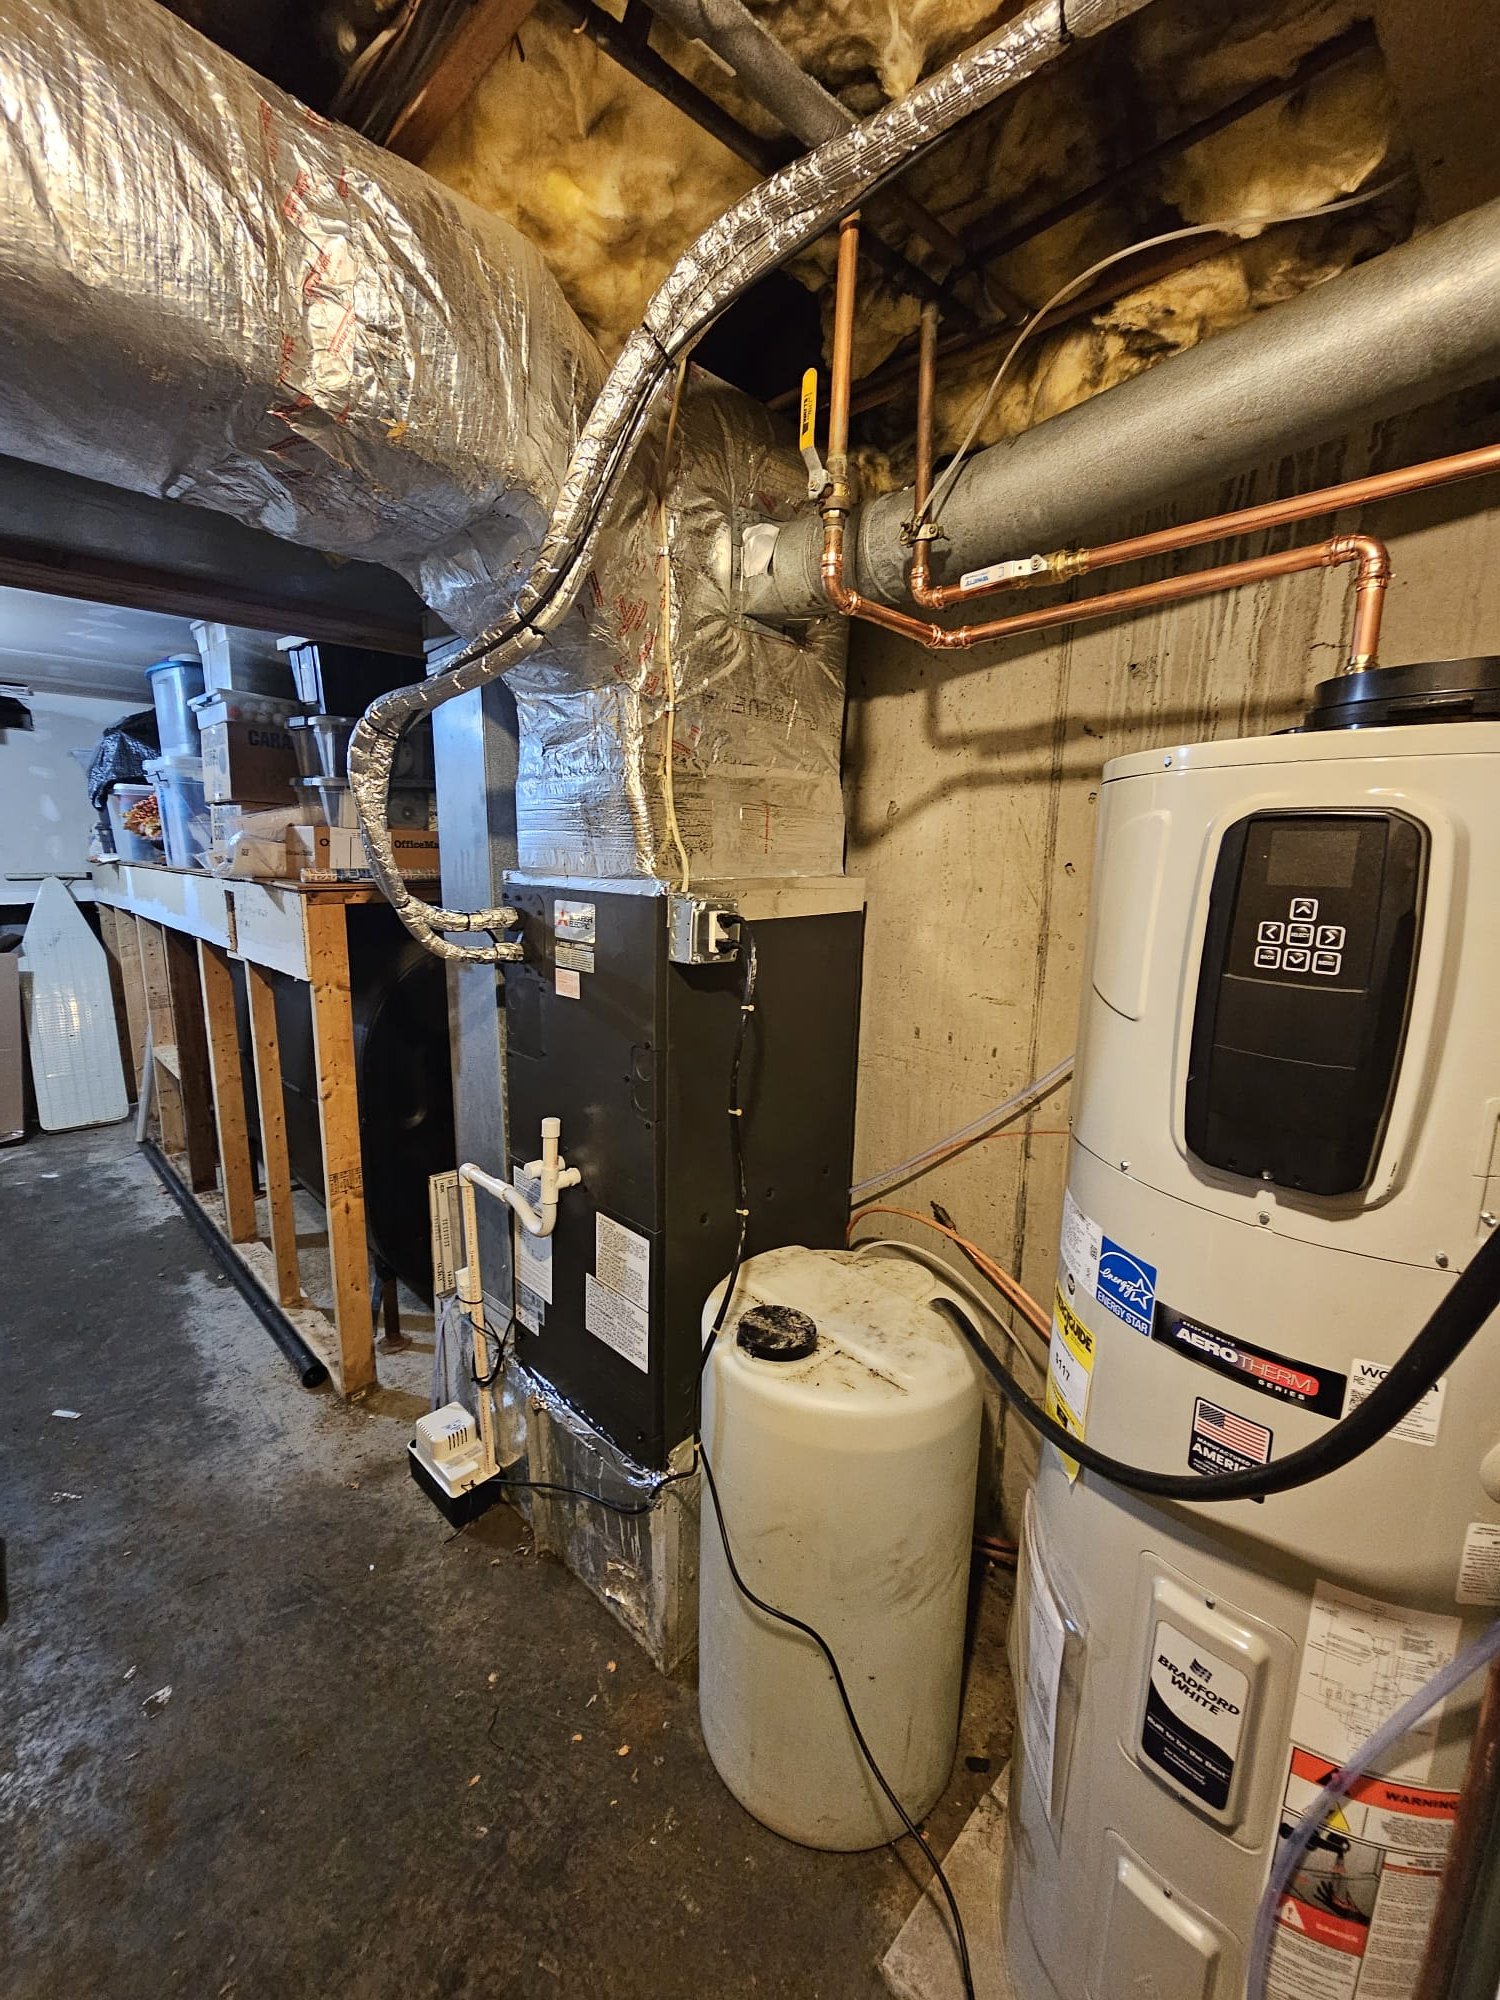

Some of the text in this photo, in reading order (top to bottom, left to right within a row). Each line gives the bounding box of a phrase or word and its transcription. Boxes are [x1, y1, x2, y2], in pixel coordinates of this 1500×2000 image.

[1097, 1291, 1149, 1335] ENERGY STAR
[1176, 1327, 1312, 1393] AEROTHERM
[1257, 1379, 1306, 1401] SERIES
[1192, 1442, 1248, 1472] AMERI
[1196, 1436, 1253, 1467] MANUFACTURED
[1157, 1654, 1241, 1716] BRADFORD
[1170, 1675, 1221, 1716] WHITE
[1146, 1714, 1165, 1734] Built
[1164, 1730, 1175, 1741] to
